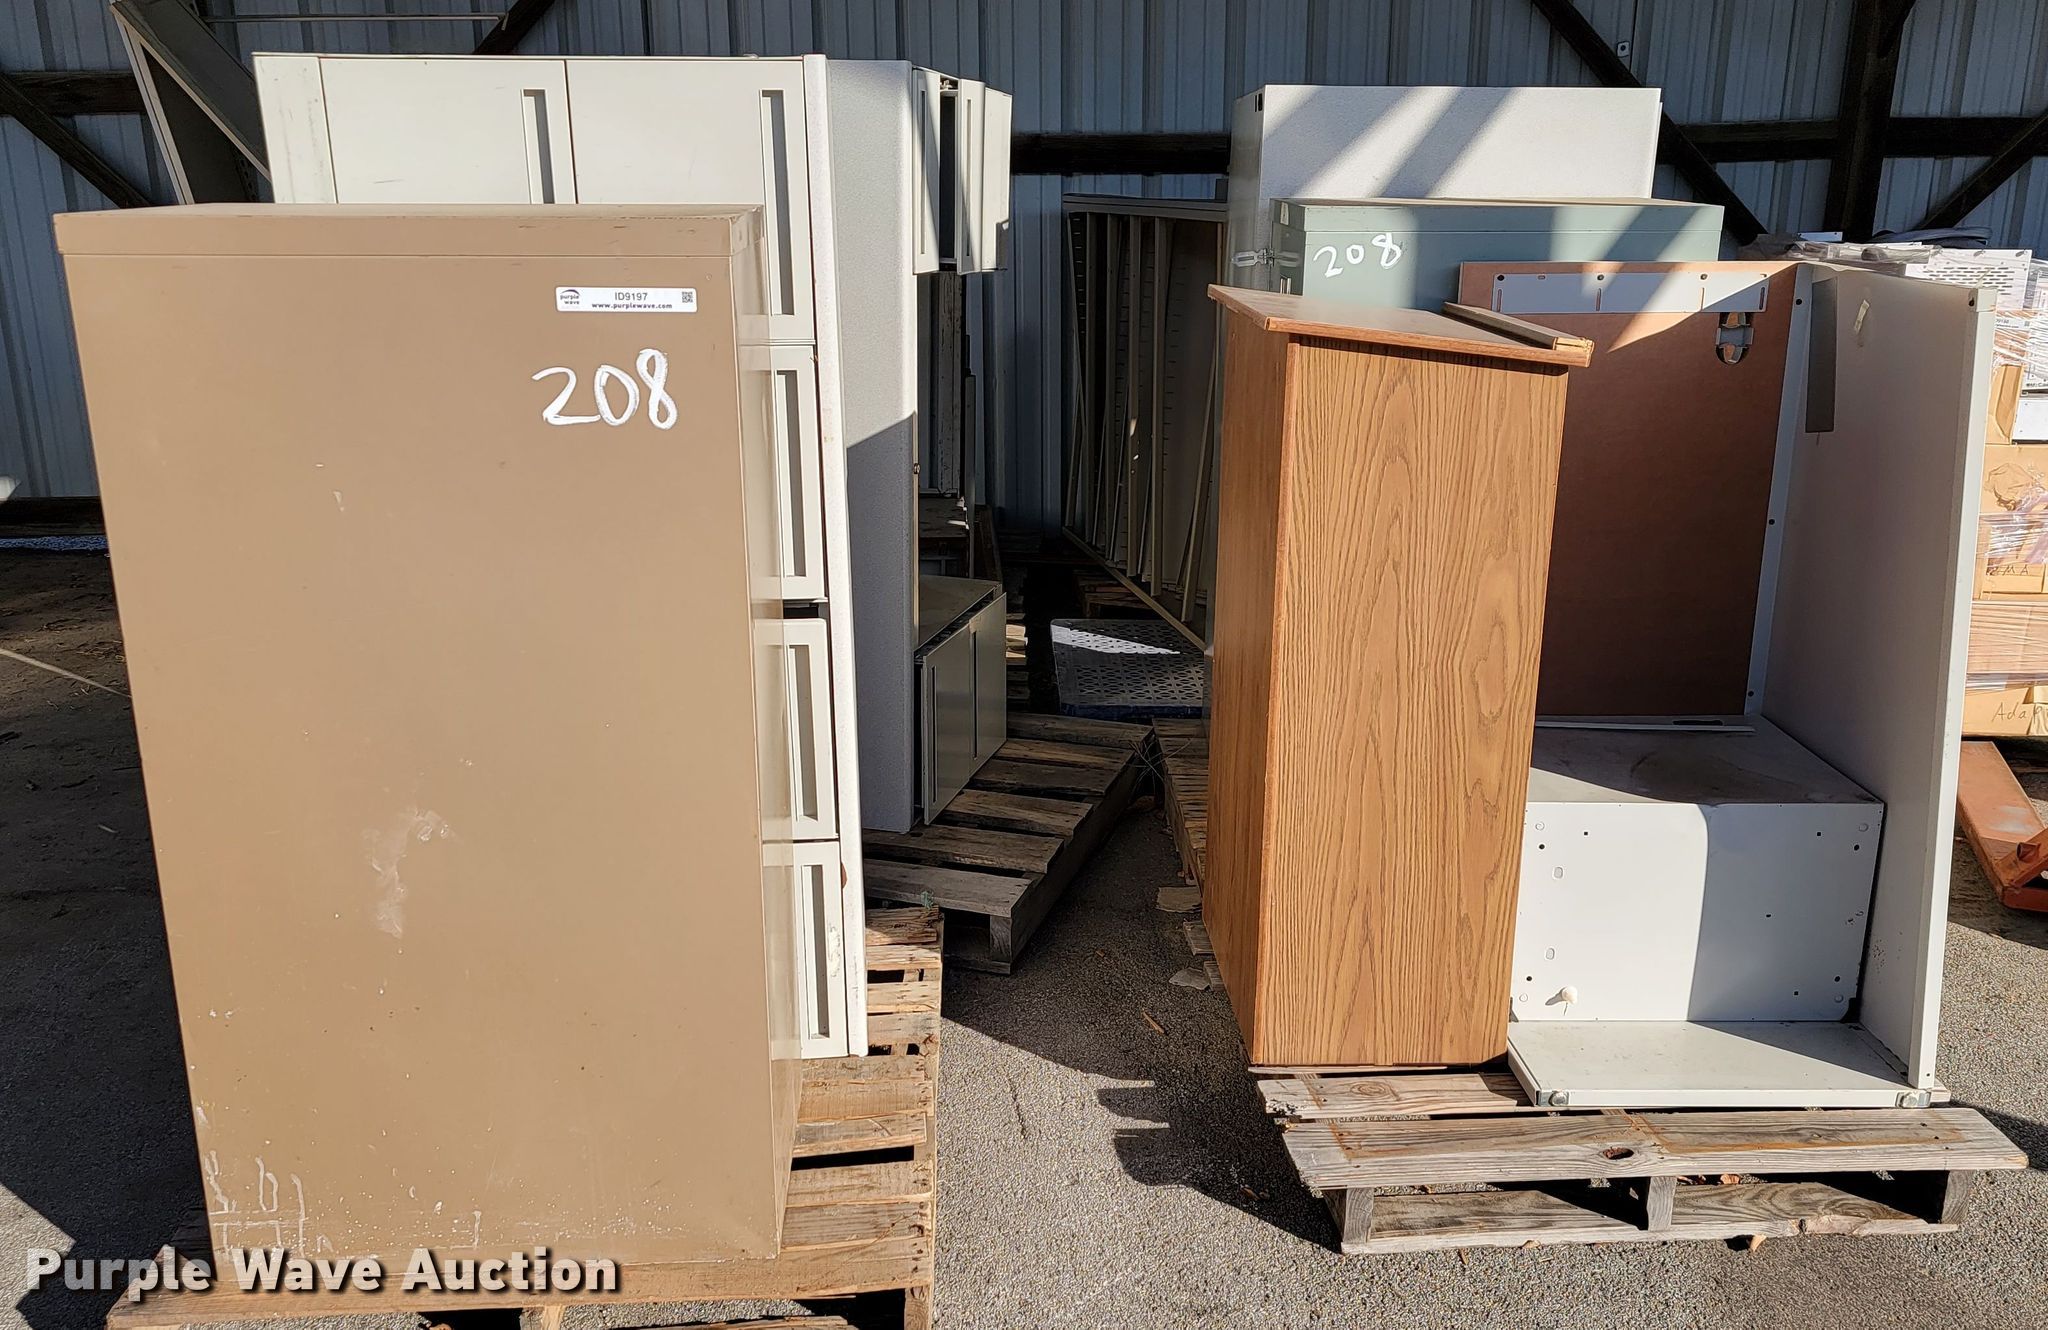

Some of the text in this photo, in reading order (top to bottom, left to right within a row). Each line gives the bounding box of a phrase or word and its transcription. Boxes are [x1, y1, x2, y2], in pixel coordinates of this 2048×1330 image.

[1313, 232, 1402, 277] 208
[614, 292, 648, 301] ID9197
[531, 348, 678, 430] 208
[1991, 701, 2048, 724] Adap
